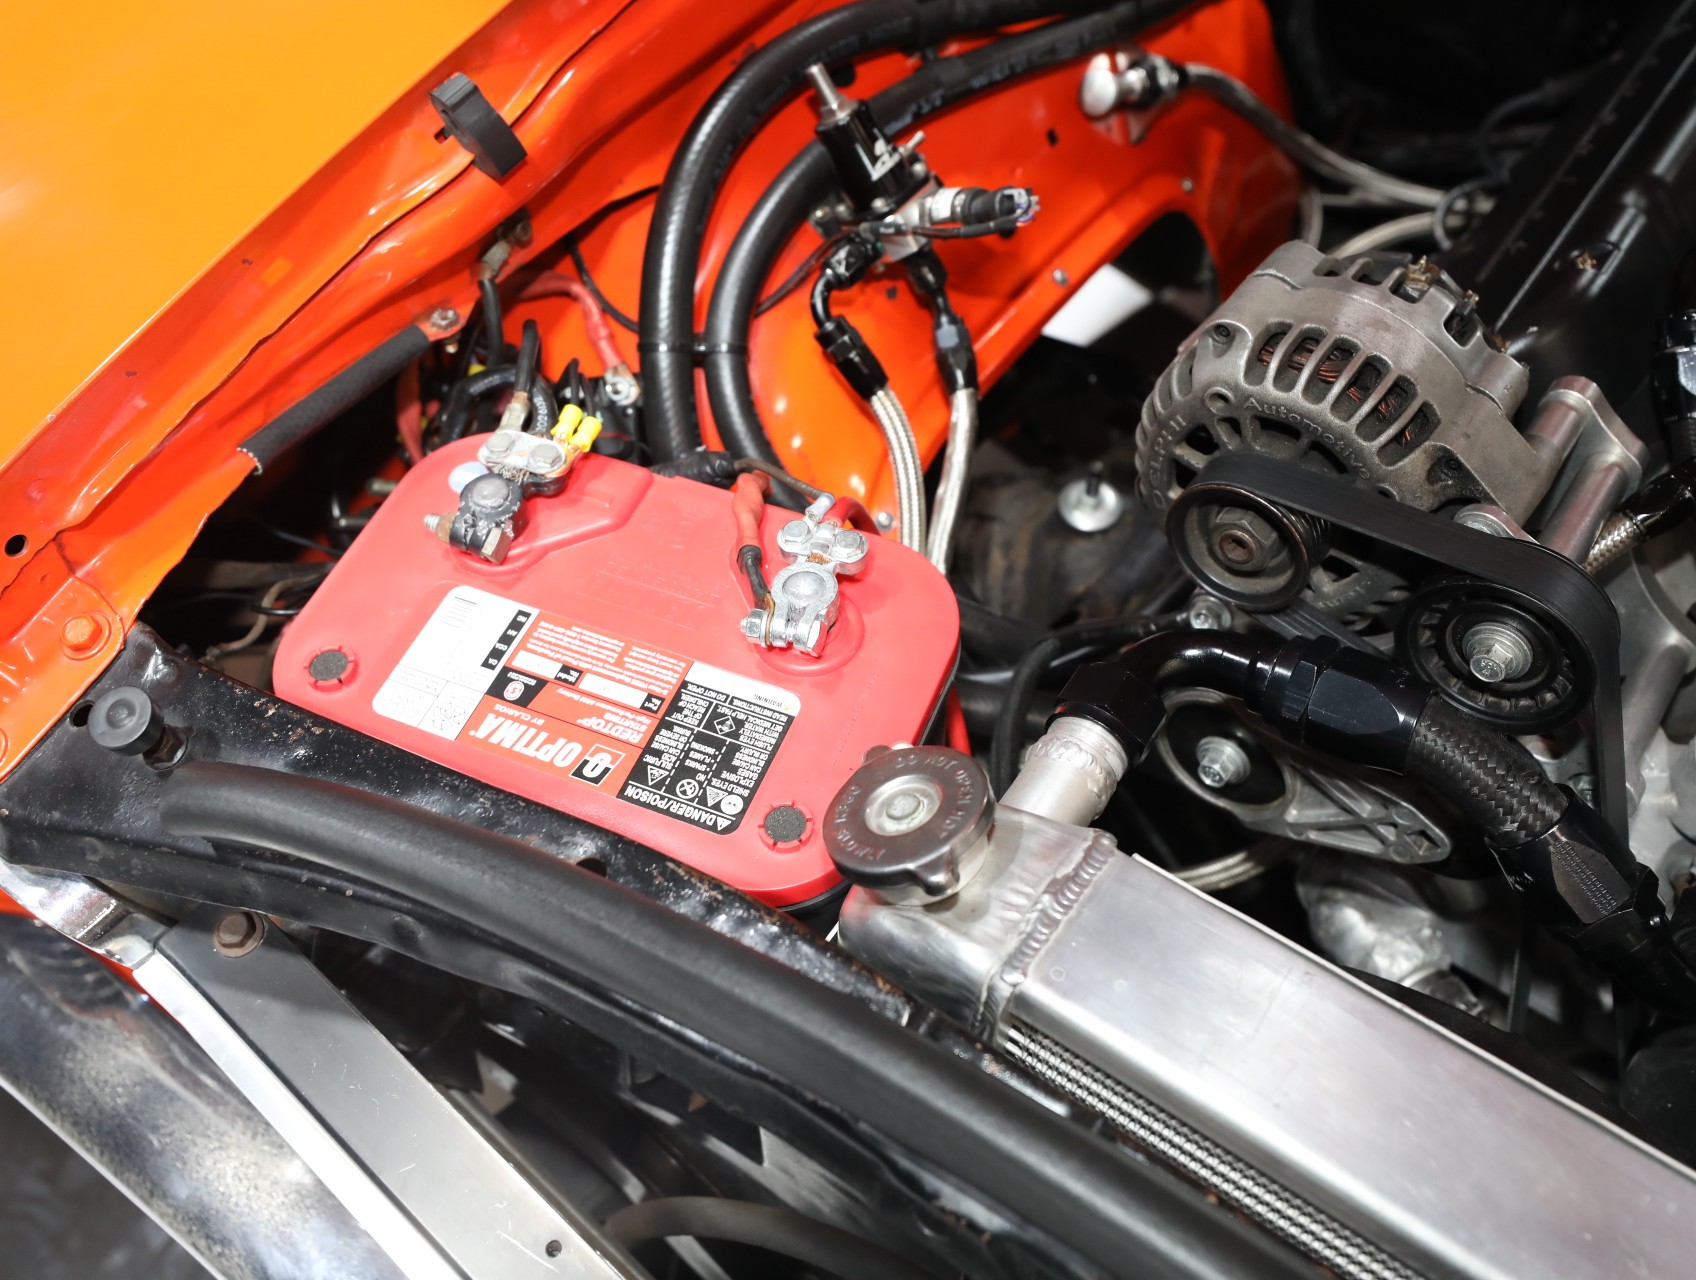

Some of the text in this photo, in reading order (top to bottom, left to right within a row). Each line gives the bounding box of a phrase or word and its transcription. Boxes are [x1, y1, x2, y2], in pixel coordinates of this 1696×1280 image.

[1244, 397, 1370, 480] Automotive
[1151, 415, 1187, 509] DELPHI
[506, 628, 518, 636] AH
[494, 642, 508, 650] CCA
[487, 657, 498, 665] CA
[556, 671, 577, 682] Model
[567, 669, 579, 677] No.
[685, 682, 726, 701] DO NOT OPEN.
[643, 701, 658, 710] Part
[649, 697, 661, 705] No.
[752, 693, 783, 707] WARNING
[492, 702, 545, 725] BY CLARIOS
[685, 702, 706, 713] REACH
[730, 698, 788, 722] READ INSTRUCTIONS.
[602, 711, 648, 732] STARTING
[670, 711, 699, 725] KEEP OUT
[693, 711, 702, 719] OF
[715, 704, 783, 732] GET MEDICAL HELP FAST.
[658, 728, 688, 743] OR SEVERE
[762, 728, 780, 738] WITH
[473, 712, 584, 770] OPTIMA
[650, 740, 681, 755] CAN CAUSE
[653, 734, 685, 749] BLINDNESS
[689, 740, 716, 754] SMOKING
[738, 734, 774, 750] FLUSH EYES
[642, 753, 674, 769] SULFURIC
[660, 752, 677, 763] ACID
[688, 750, 711, 763] FLAMES
[734, 751, 765, 766] BLINDNESS
[758, 752, 768, 760] OR
[684, 758, 707, 771] SPARKS
[731, 757, 762, 773] CAN CAUSE
[695, 772, 706, 781] NO
[720, 770, 755, 787] EXPLOSIVE
[736, 767, 759, 780] GASES
[709, 777, 750, 796] SHIELD EYES.
[623, 784, 717, 825] DANGER/POISON
